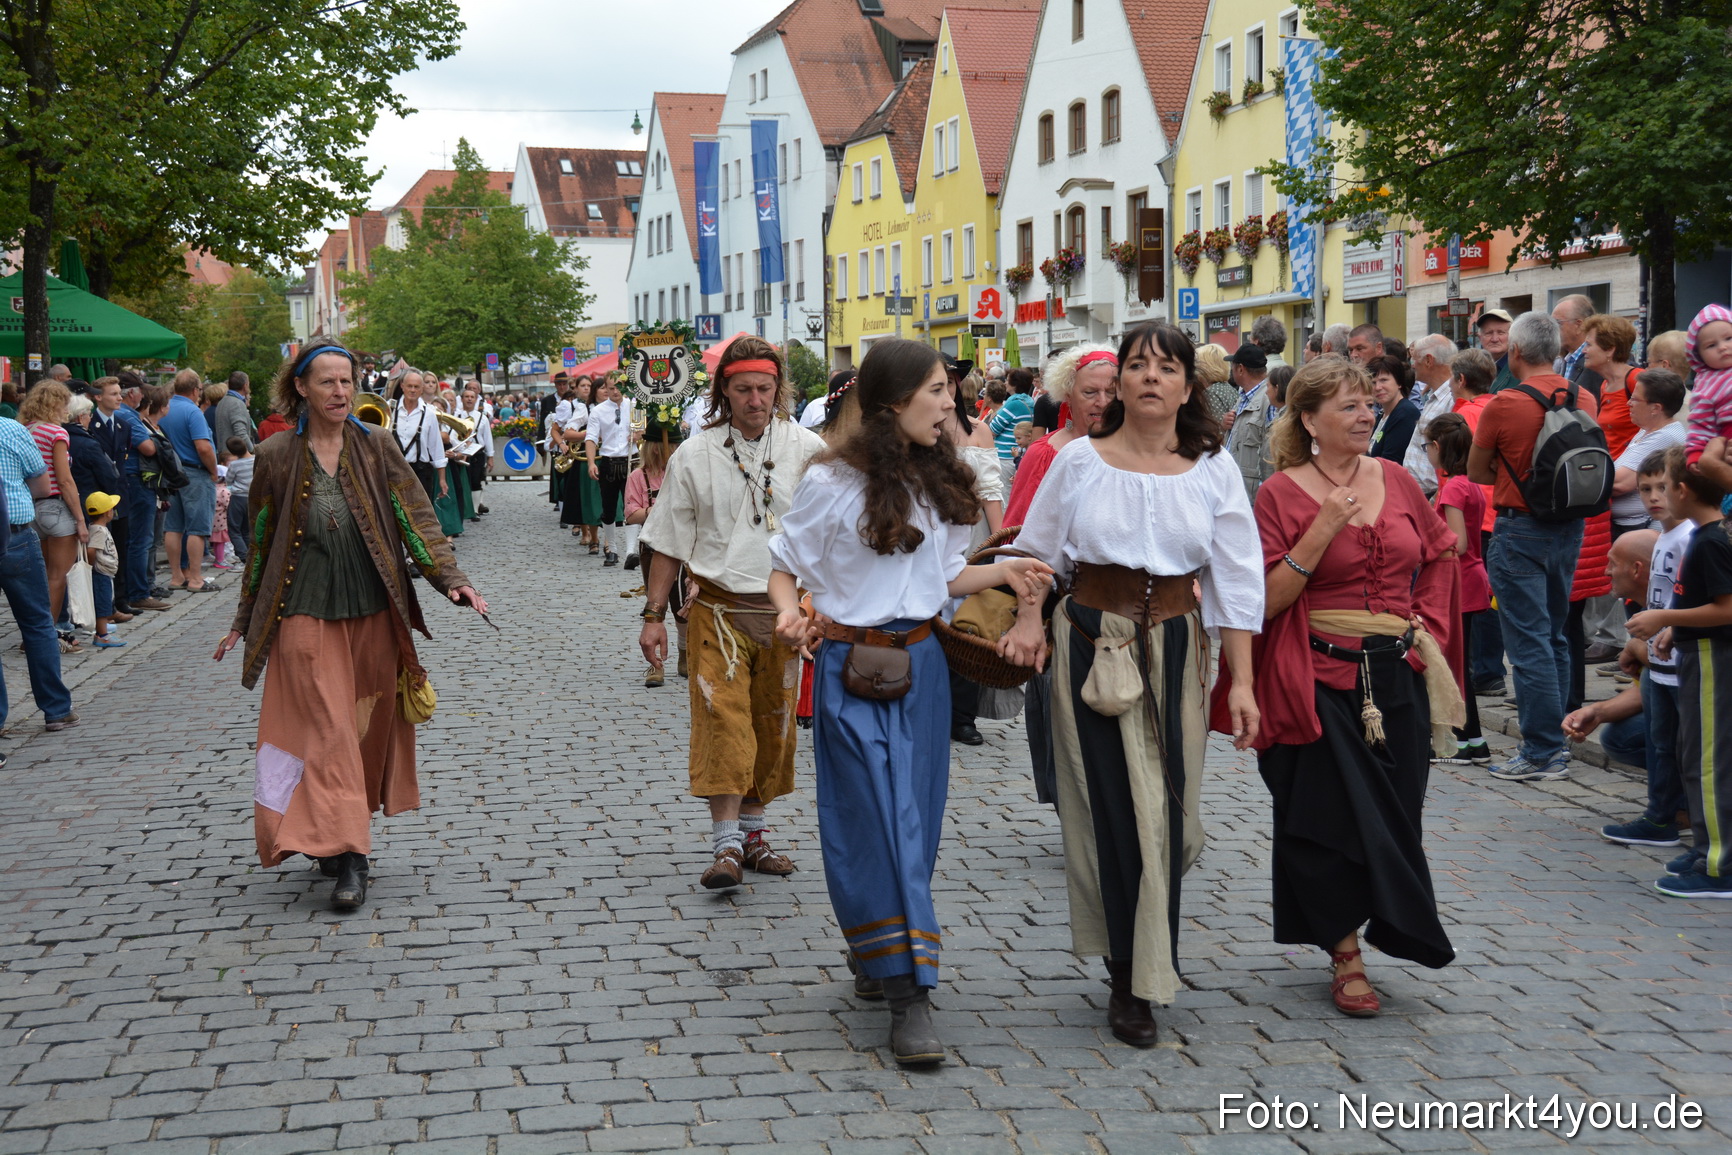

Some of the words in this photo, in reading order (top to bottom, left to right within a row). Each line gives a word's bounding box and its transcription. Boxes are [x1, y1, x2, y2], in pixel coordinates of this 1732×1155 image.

[757, 182, 771, 221] K&L
[863, 222, 883, 242] HOTEL
[888, 218, 910, 235] Lehmeier
[1460, 246, 1482, 258] DER
[1371, 259, 1383, 273] KINO
[1425, 257, 1438, 270] DER
[1217, 272, 1231, 283] WOLLE
[1182, 291, 1195, 316] P
[862, 317, 890, 331] Restaurant
[1208, 317, 1223, 328] WOLLE
[636, 336, 679, 347] PYRBAUM
[651, 396, 664, 406] DER
